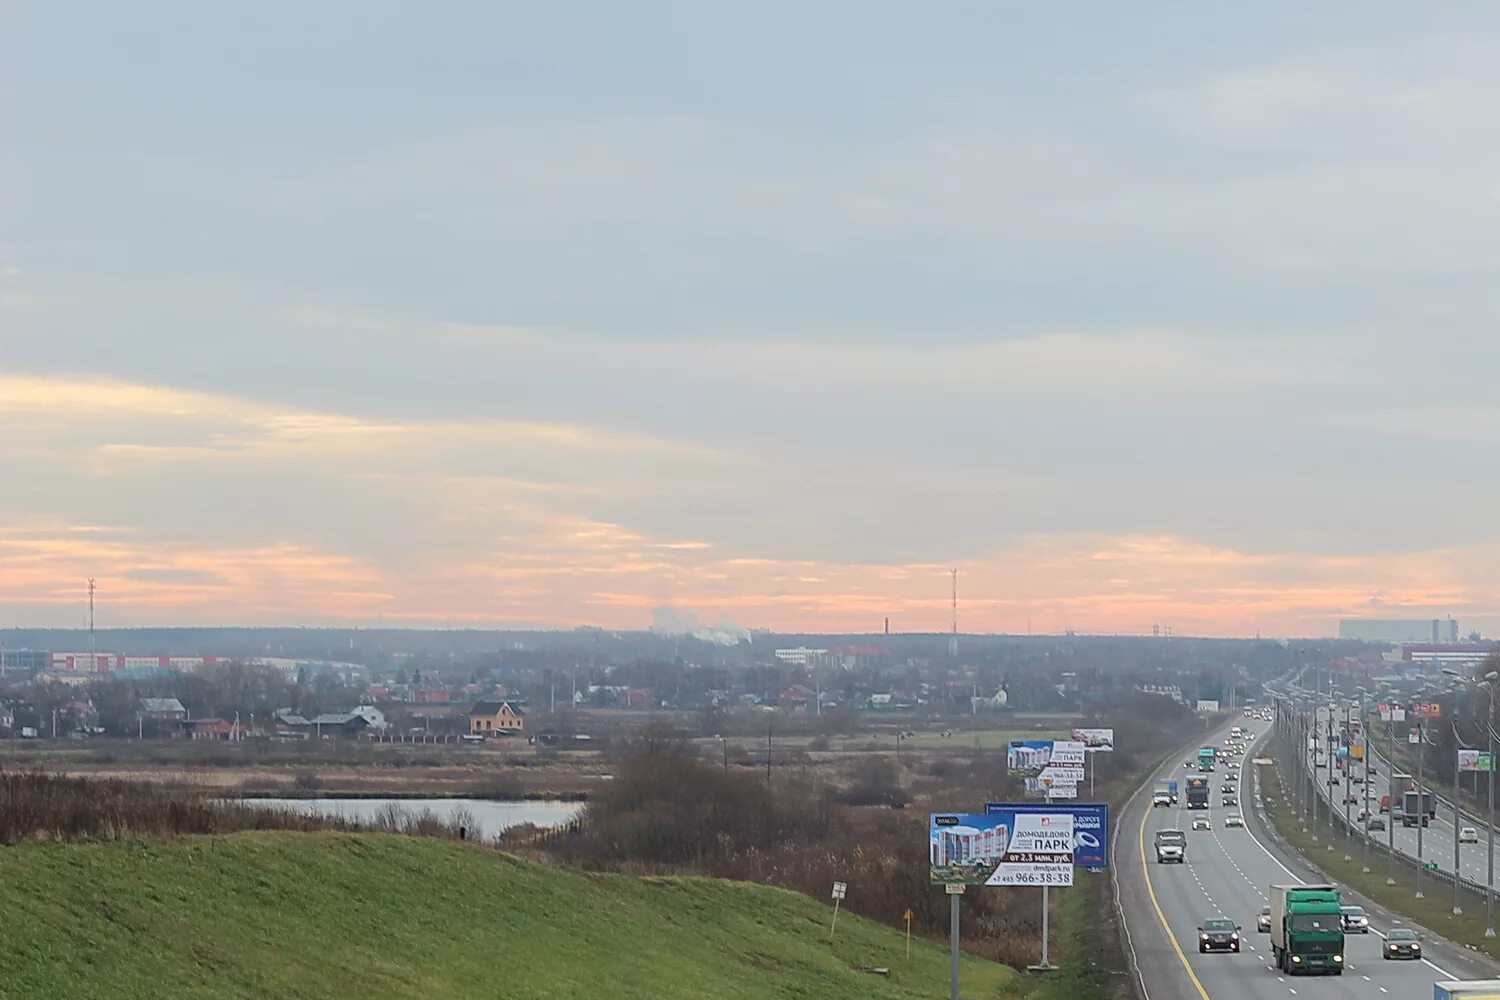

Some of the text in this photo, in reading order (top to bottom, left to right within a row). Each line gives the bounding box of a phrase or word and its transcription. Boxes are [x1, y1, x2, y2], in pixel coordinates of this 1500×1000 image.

[1016, 830, 1070, 839] ДОМОДЕДОВО
[1034, 839, 1070, 850] ПАРК
[1009, 854, 1020, 862] от
[1033, 864, 1071, 873] dmdpark.ru
[1015, 873, 1070, 883] 966-38-38
